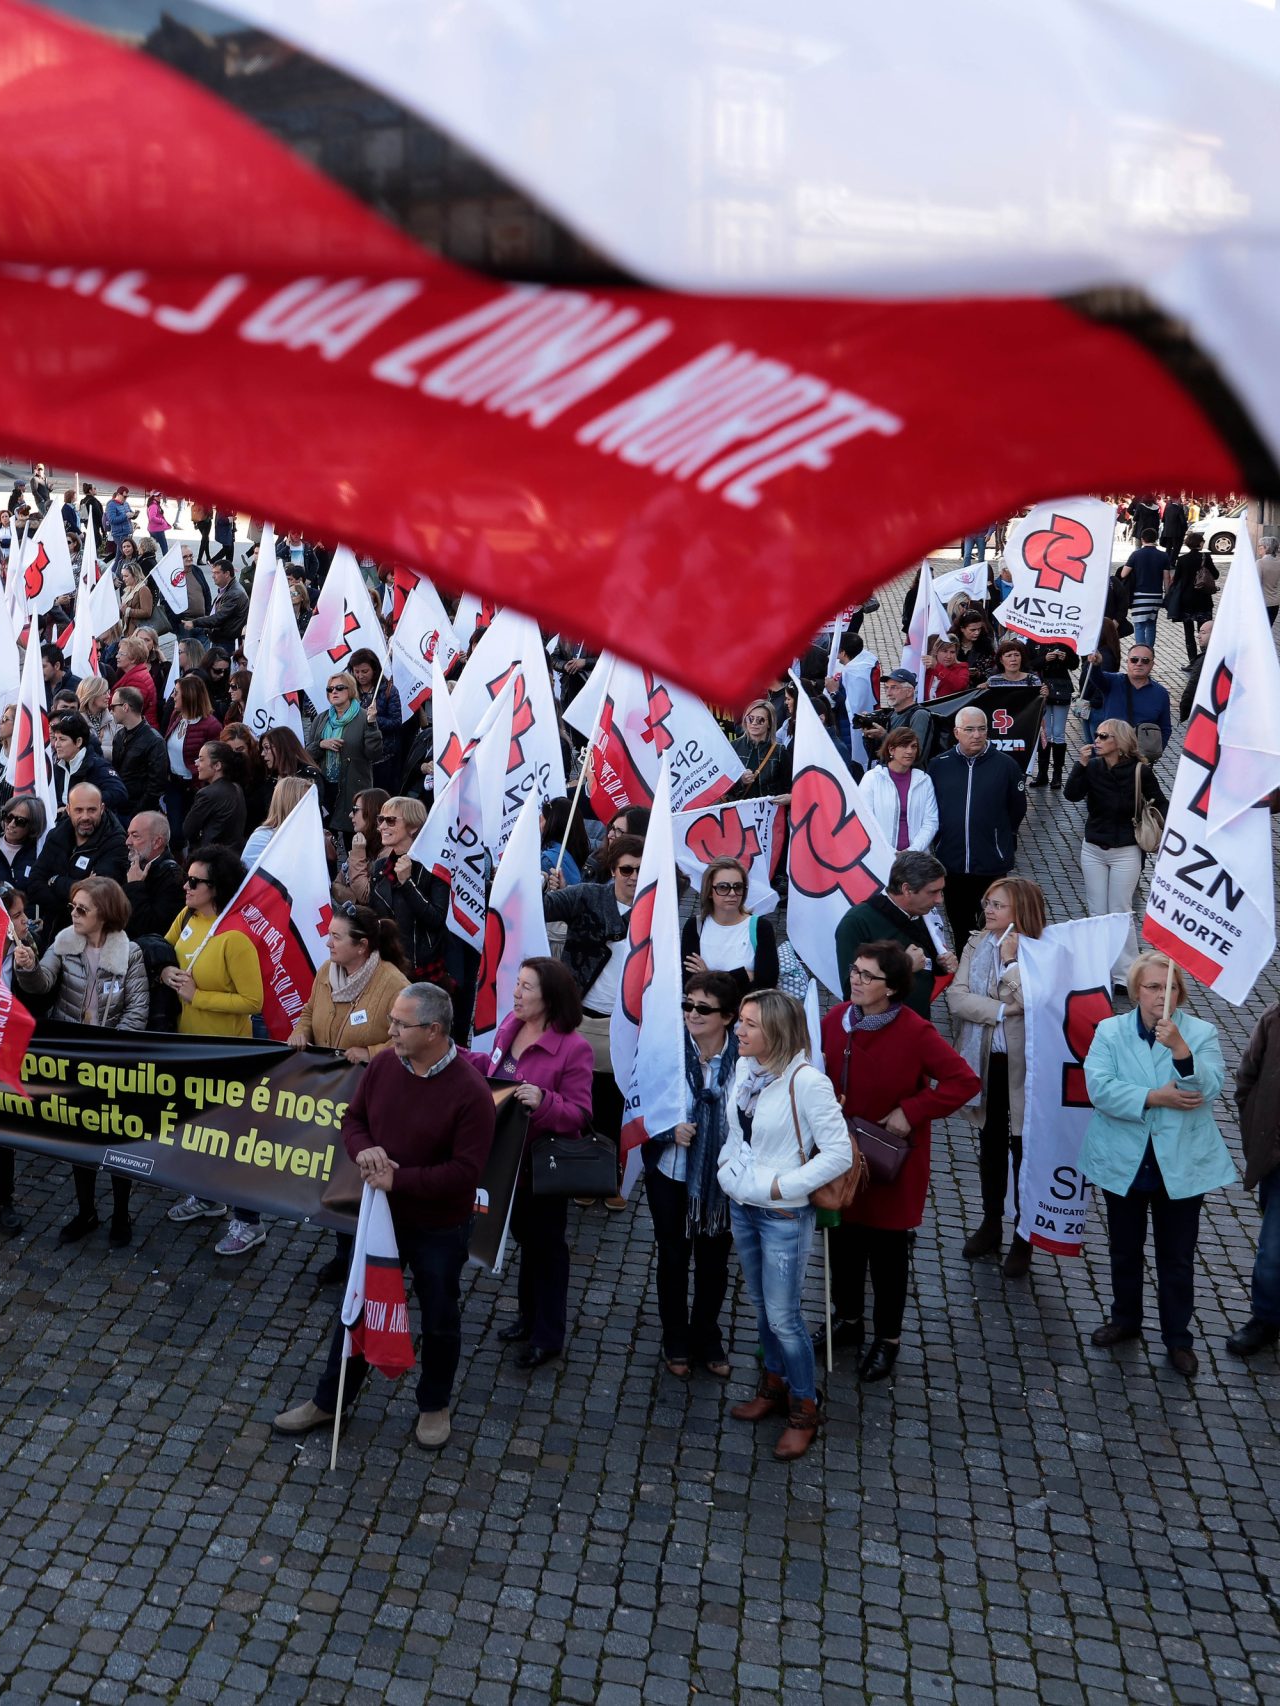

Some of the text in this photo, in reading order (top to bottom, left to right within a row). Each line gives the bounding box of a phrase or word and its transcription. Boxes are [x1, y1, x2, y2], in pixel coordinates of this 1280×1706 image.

[370, 281, 675, 430] ZONA
[577, 338, 906, 509] NORTE
[1155, 877, 1243, 938] DOS PROFESSORES
[1170, 909, 1234, 957] NORTE
[77, 1061, 177, 1099] aquilo
[184, 1075, 246, 1110] que
[250, 1076, 271, 1113] é
[40, 1093, 153, 1141] direito.
[158, 1102, 178, 1146] É
[180, 1123, 230, 1159] um
[234, 1127, 336, 1182] dever!
[109, 1154, 149, 1171] WWW.SPZN.PT
[1034, 1213, 1057, 1232] DA
[1038, 1200, 1085, 1216] SINDICATO
